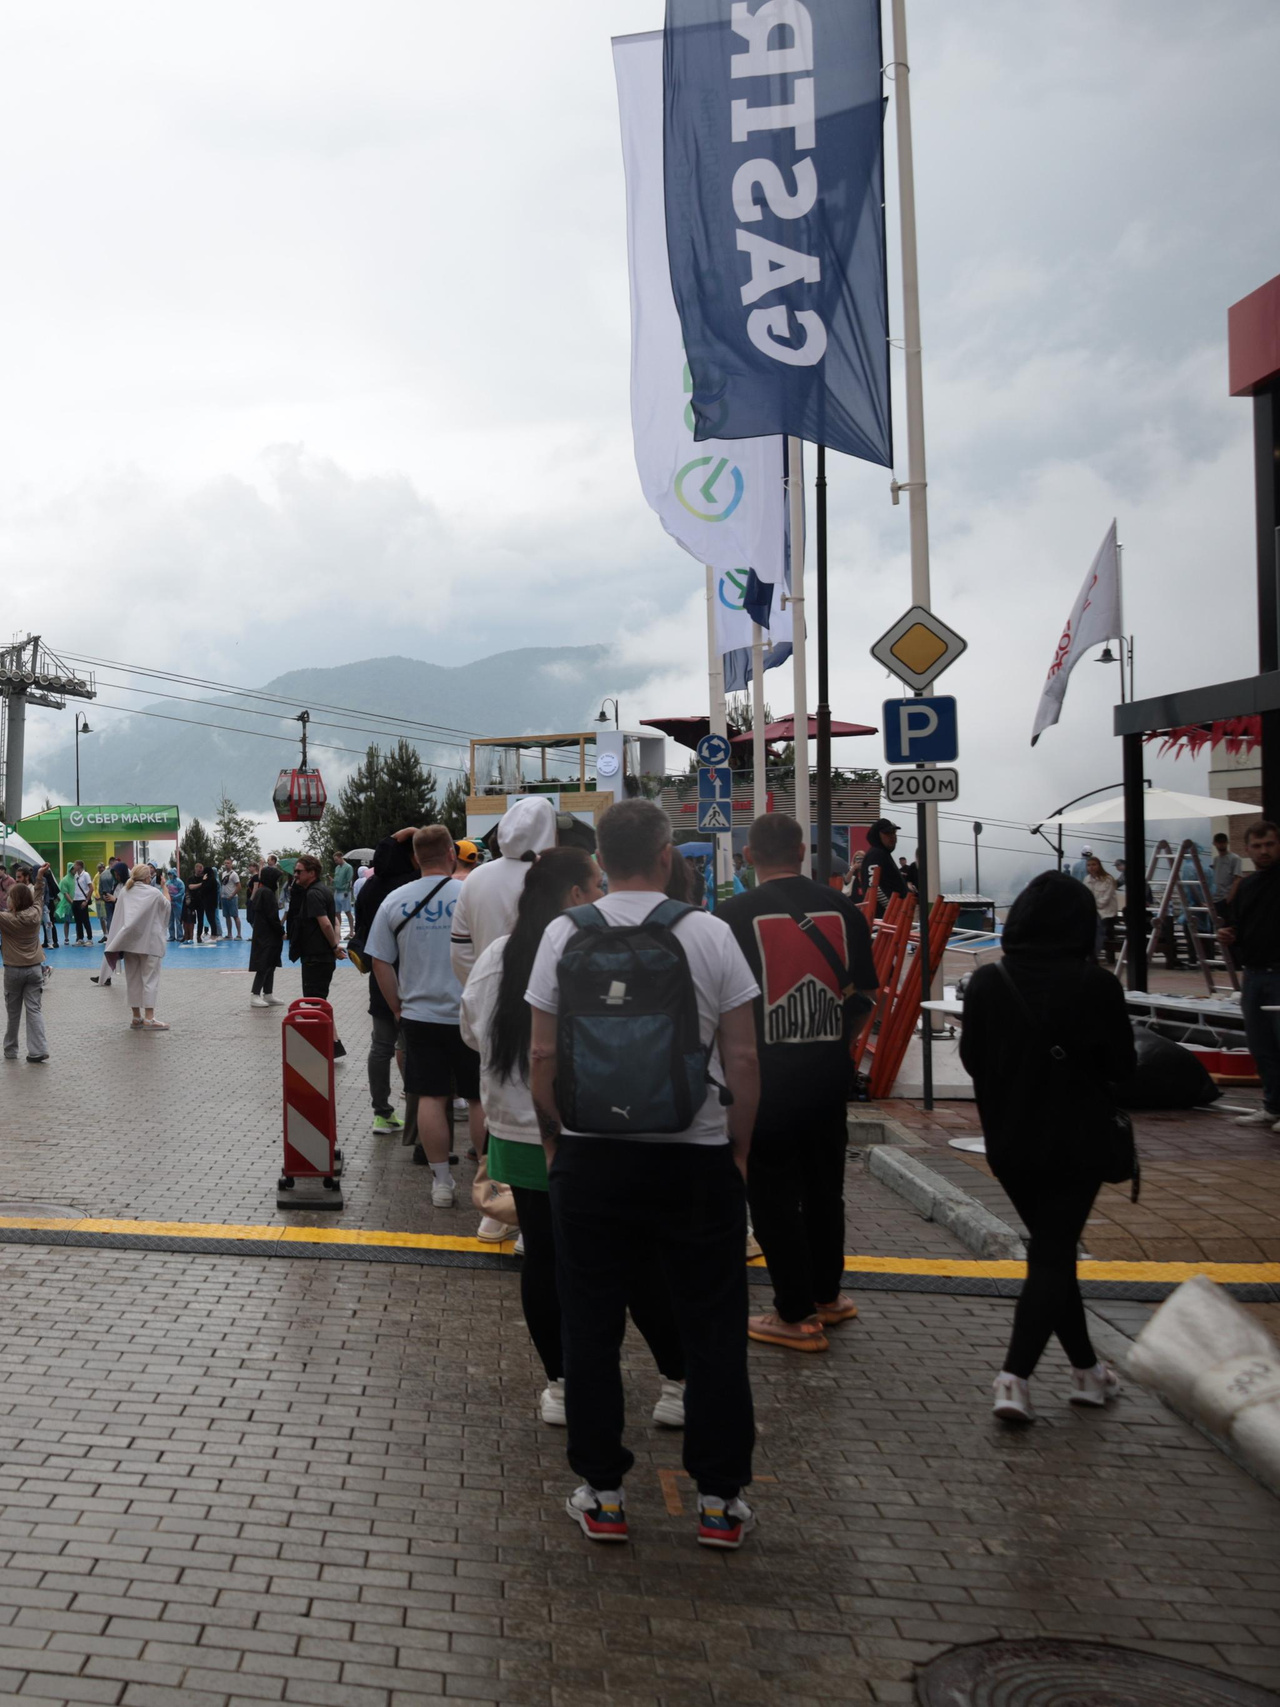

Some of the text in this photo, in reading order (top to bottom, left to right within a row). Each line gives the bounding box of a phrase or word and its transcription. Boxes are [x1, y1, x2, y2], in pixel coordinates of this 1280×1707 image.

[899, 704, 939, 757] P
[86, 811, 169, 824] СБЕР МАРКЕТ
